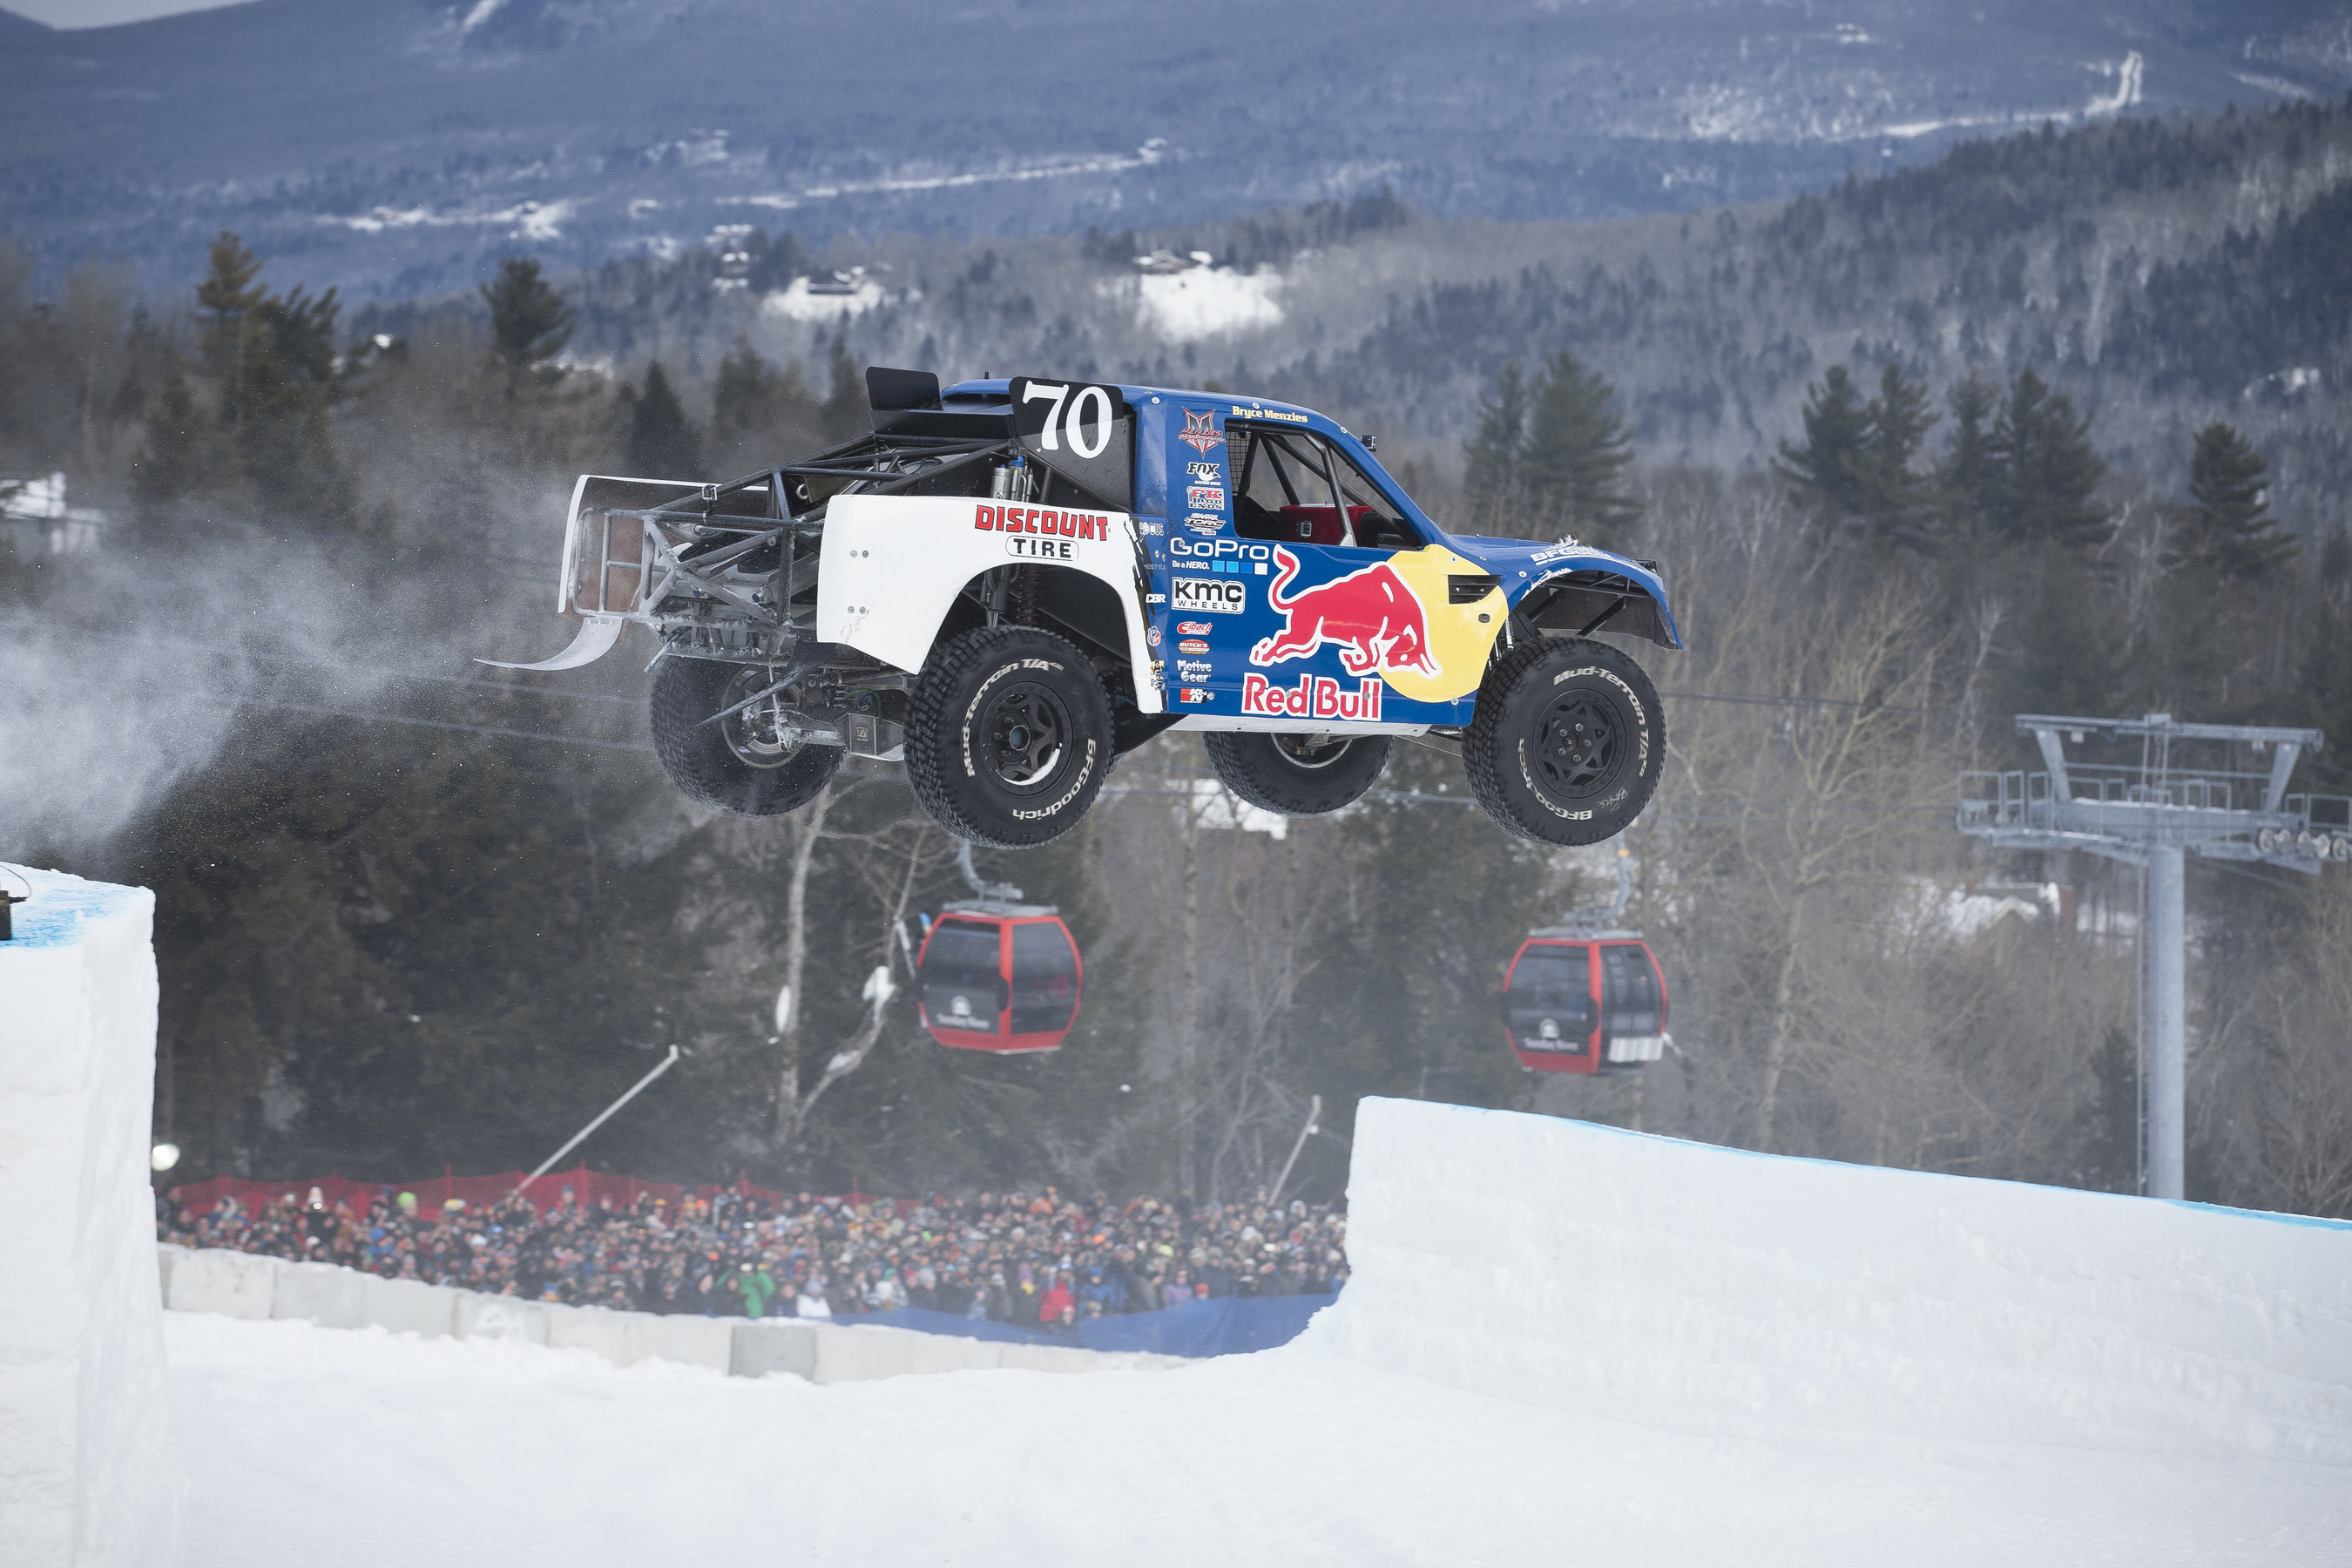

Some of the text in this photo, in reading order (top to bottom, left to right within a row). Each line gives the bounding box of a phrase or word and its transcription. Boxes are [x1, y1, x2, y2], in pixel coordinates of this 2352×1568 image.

[1023, 381, 1112, 459] 70
[1232, 405, 1308, 423] Bryce Menzies
[1187, 463, 1219, 475] FOX
[1192, 489, 1221, 499] FK
[975, 504, 1108, 541] DISCOUNT
[1013, 538, 1071, 558] TIRE
[1170, 537, 1269, 560] GoPro
[1186, 560, 1210, 570] HERO.
[1178, 600, 1238, 611] WHEELS
[1178, 621, 1213, 634] Eibach
[1177, 659, 1213, 672] Motive
[1180, 671, 1209, 683] Gear
[1243, 675, 1382, 719] Red Bull
[1553, 666, 1646, 726] Mud-Terrain
[962, 661, 1019, 778] Mud-Terrain
[1012, 738, 1097, 821] BFGoodrich
[1518, 738, 1593, 821] BFGoodrich
